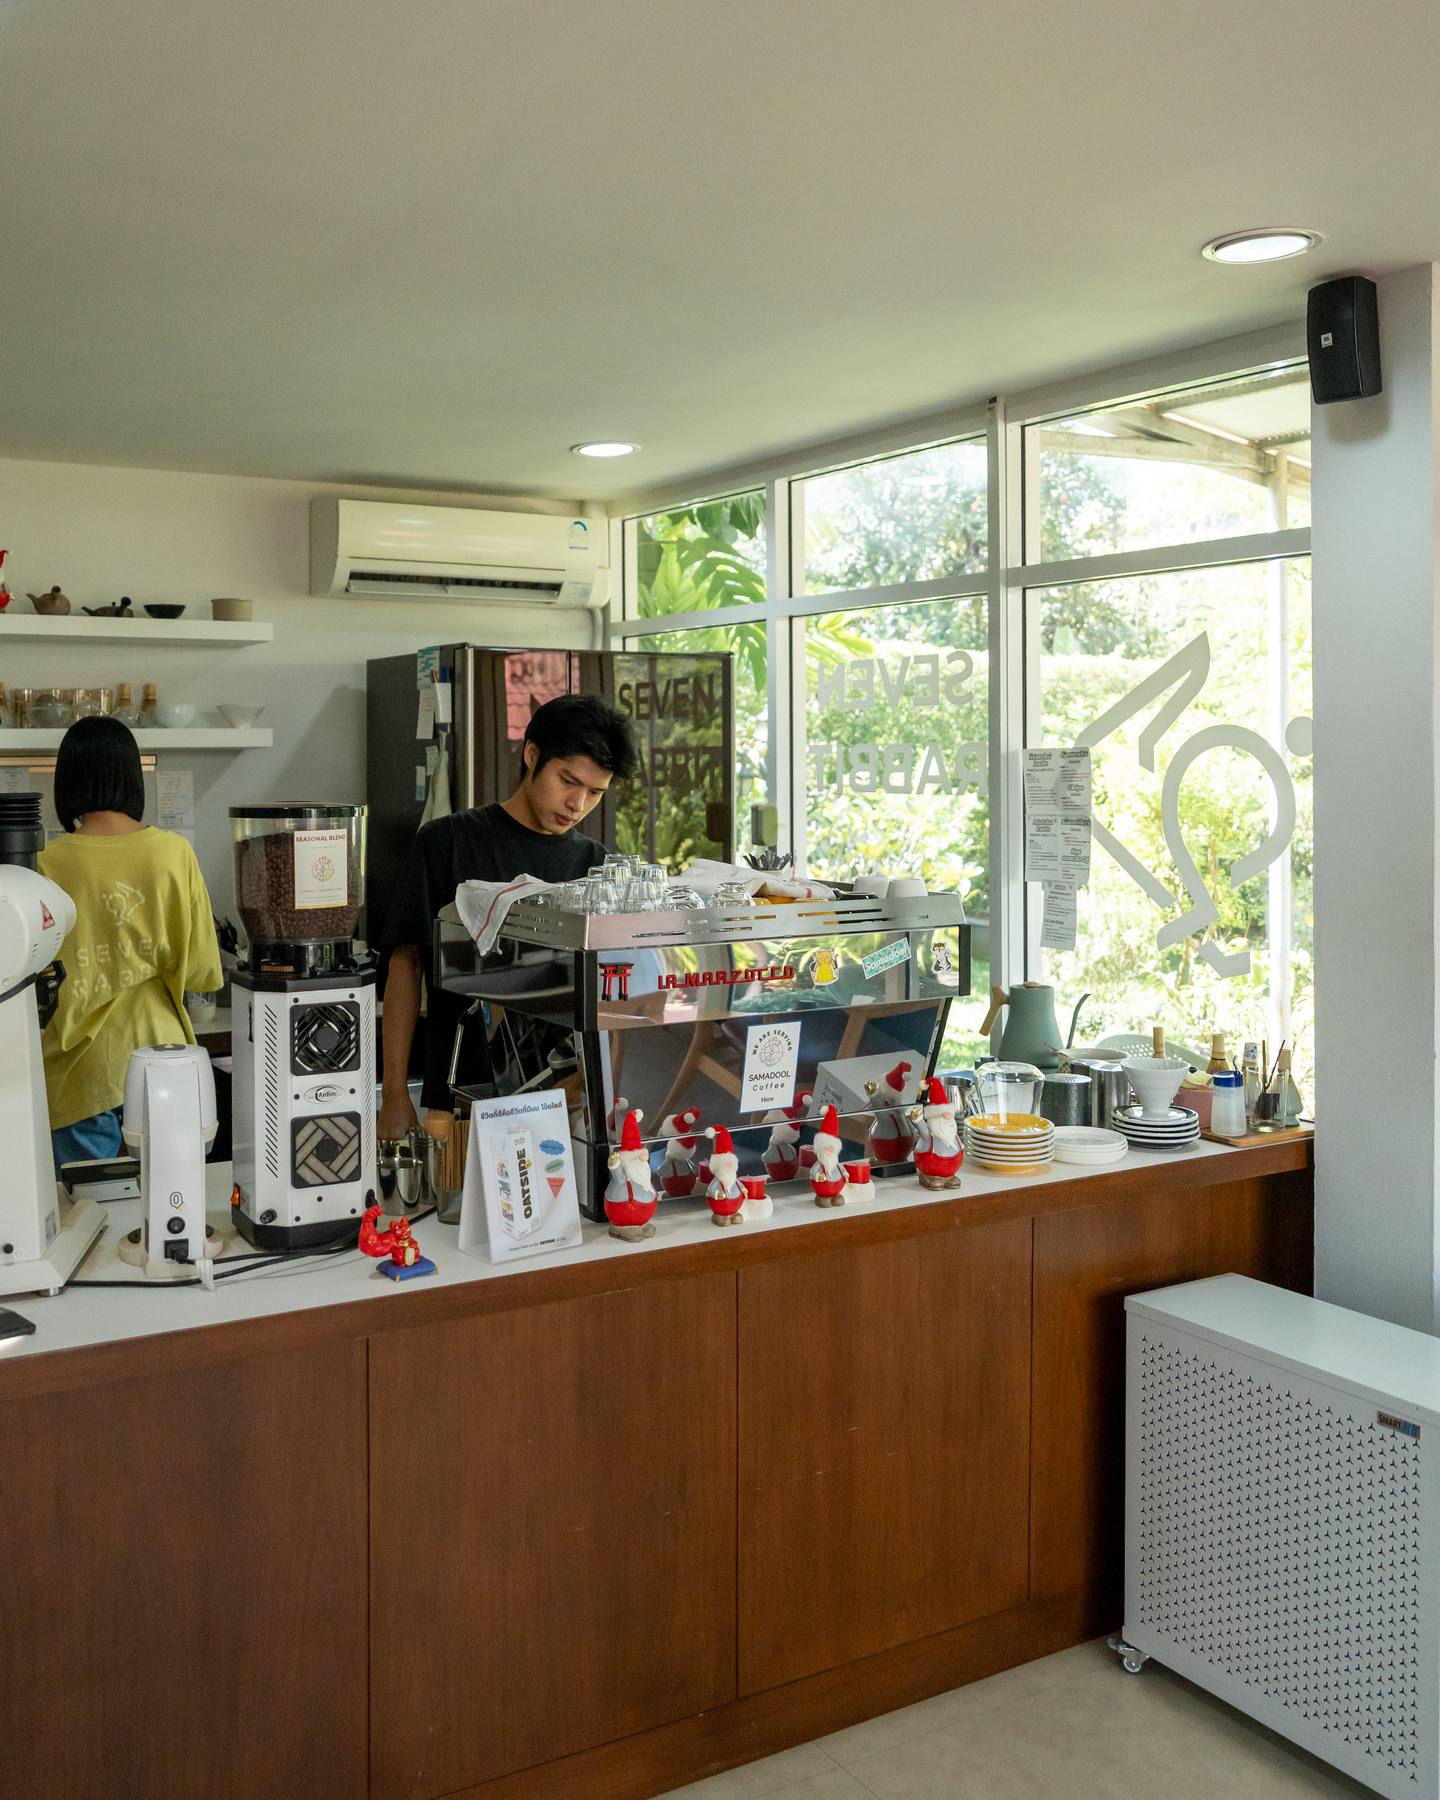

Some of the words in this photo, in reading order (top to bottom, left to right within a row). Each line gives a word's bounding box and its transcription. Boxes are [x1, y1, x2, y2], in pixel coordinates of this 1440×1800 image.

[619, 674, 714, 721] SEVEN
[295, 835, 328, 843] SEASONAL
[72, 964, 154, 1000] RABB
[752, 1044, 759, 1056] WE
[758, 1031, 771, 1043] ARE
[773, 1029, 793, 1052] SERVING
[748, 1070, 791, 1082] SAMADOOL
[752, 1083, 785, 1092] Coffee
[517, 1148, 533, 1219] OATSIDE
